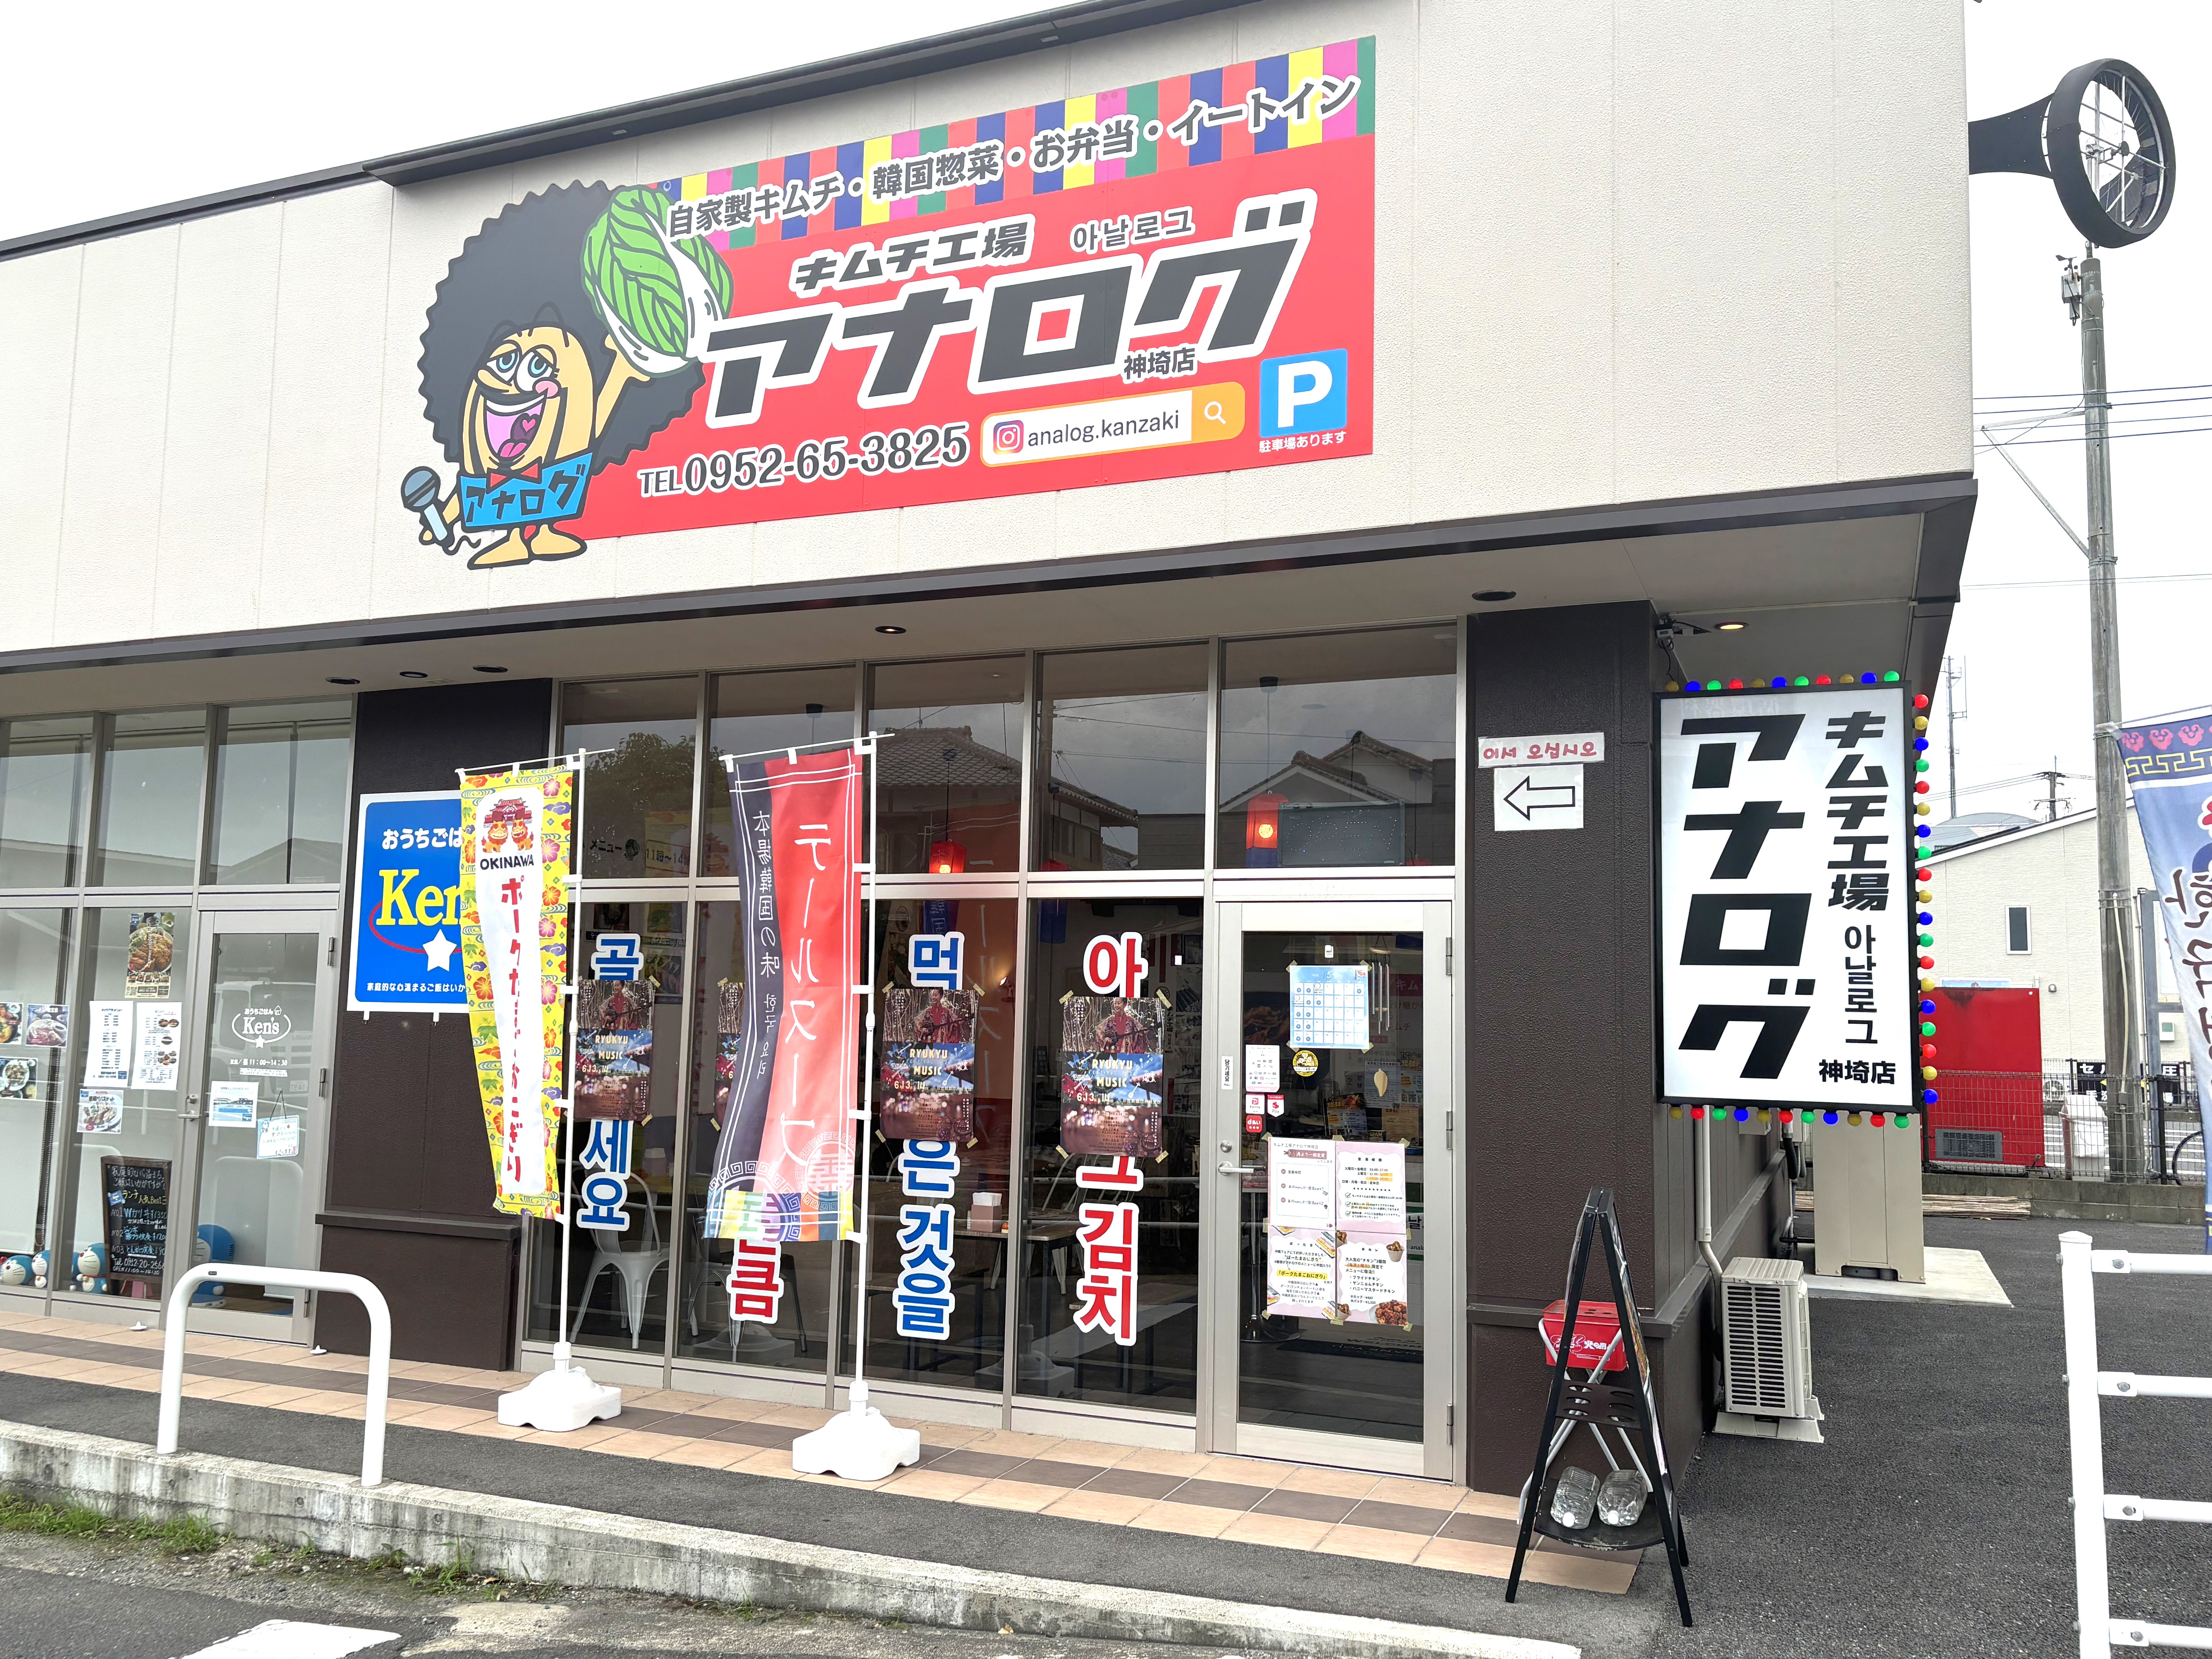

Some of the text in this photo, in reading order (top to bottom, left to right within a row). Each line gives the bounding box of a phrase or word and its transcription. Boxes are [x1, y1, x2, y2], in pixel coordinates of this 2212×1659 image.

[1073, 208, 1194, 251] 아날로그
[795, 221, 1029, 290] キムチ工場
[707, 200, 1305, 417] アナログ
[1123, 347, 1195, 380] 神埼店
[1027, 410, 1180, 447] analog.kanzaki
[1259, 431, 1347, 453] 駐車場あります
[640, 426, 967, 495] TEL 0952-65-3825
[465, 462, 584, 523] アナログ
[1825, 711, 1889, 911] キムチ工場
[480, 854, 534, 871] OKINAWA
[1678, 713, 1815, 1079] アナログ
[1844, 924, 1878, 1045] 아날로그
[242, 1017, 280, 1035] Ken's
[595, 1035, 629, 1044] RYUKYU
[599, 1050, 623, 1060] MUSIC
[910, 1048, 948, 1059] RYUKYU
[1092, 1059, 1133, 1070] RYUKYU
[914, 1066, 942, 1076] MUSIC
[1097, 1076, 1128, 1088] MUSIC
[1819, 1060, 1896, 1084] 神埼店
